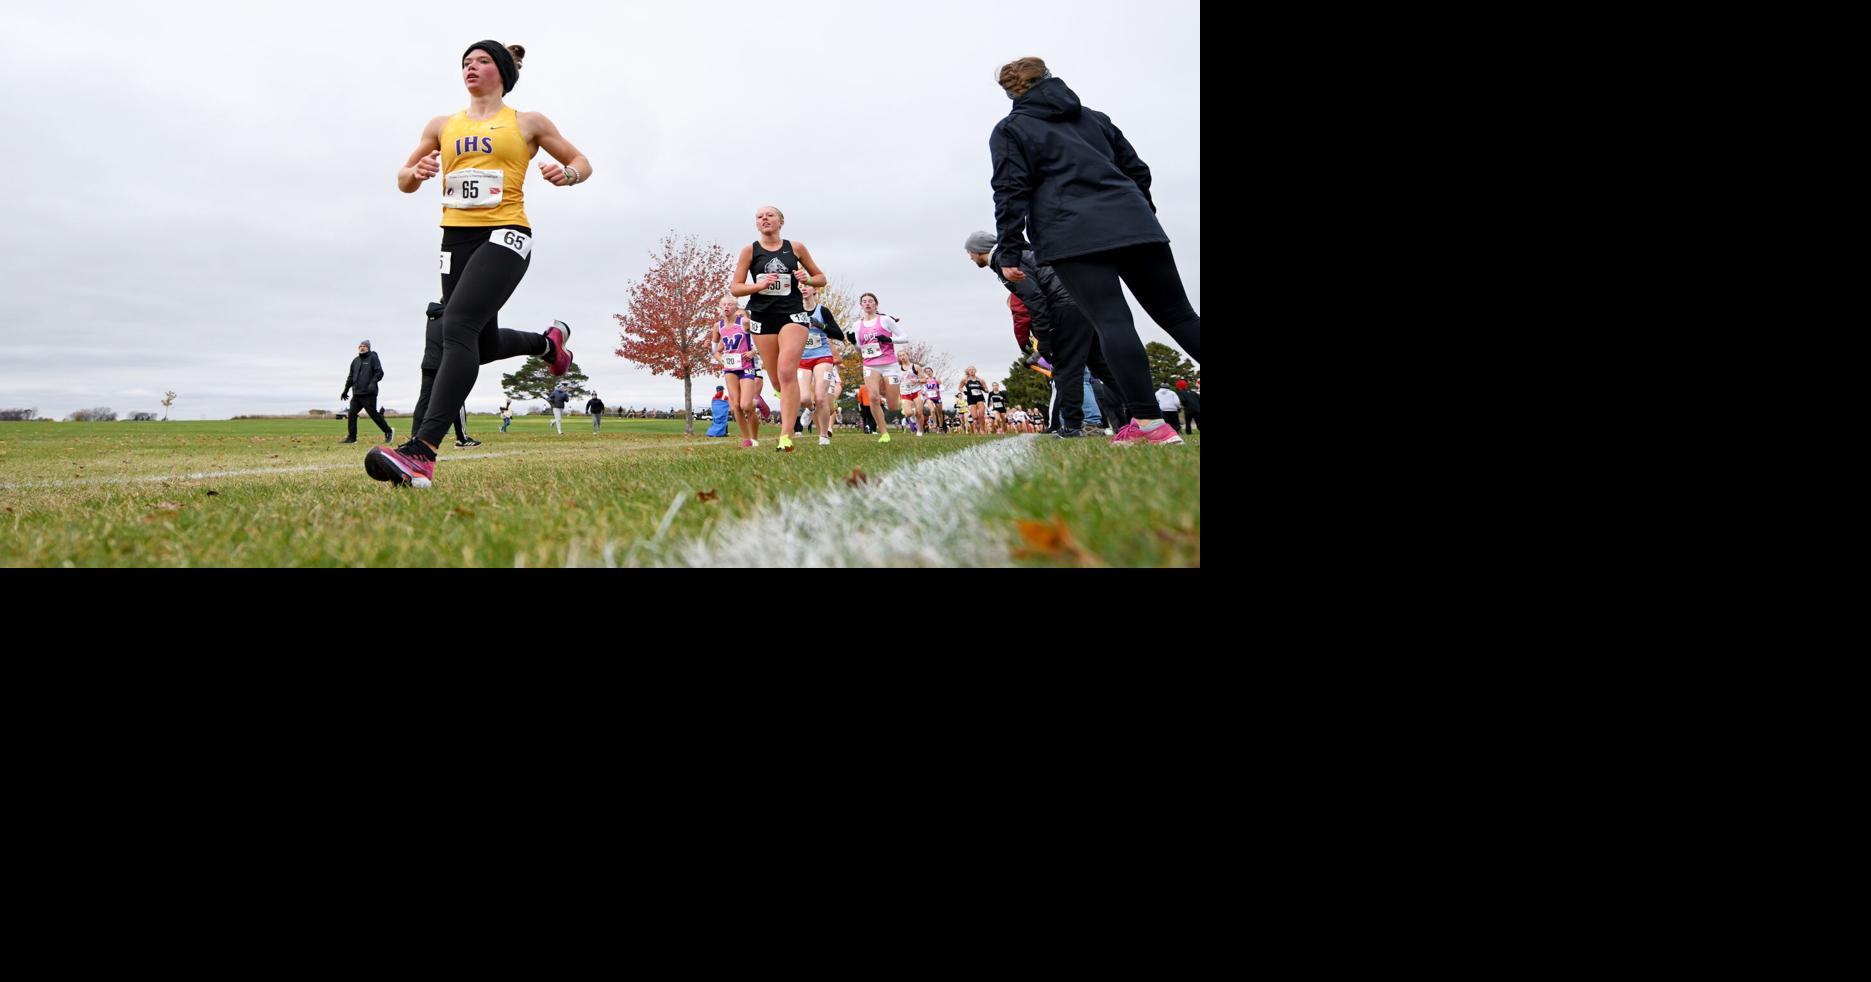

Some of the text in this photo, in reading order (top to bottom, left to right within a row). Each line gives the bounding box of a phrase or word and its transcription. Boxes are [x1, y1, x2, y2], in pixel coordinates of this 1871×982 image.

[456, 136, 493, 156] IHS
[462, 180, 479, 199] 65
[503, 231, 525, 250] 65
[722, 333, 743, 351] W
